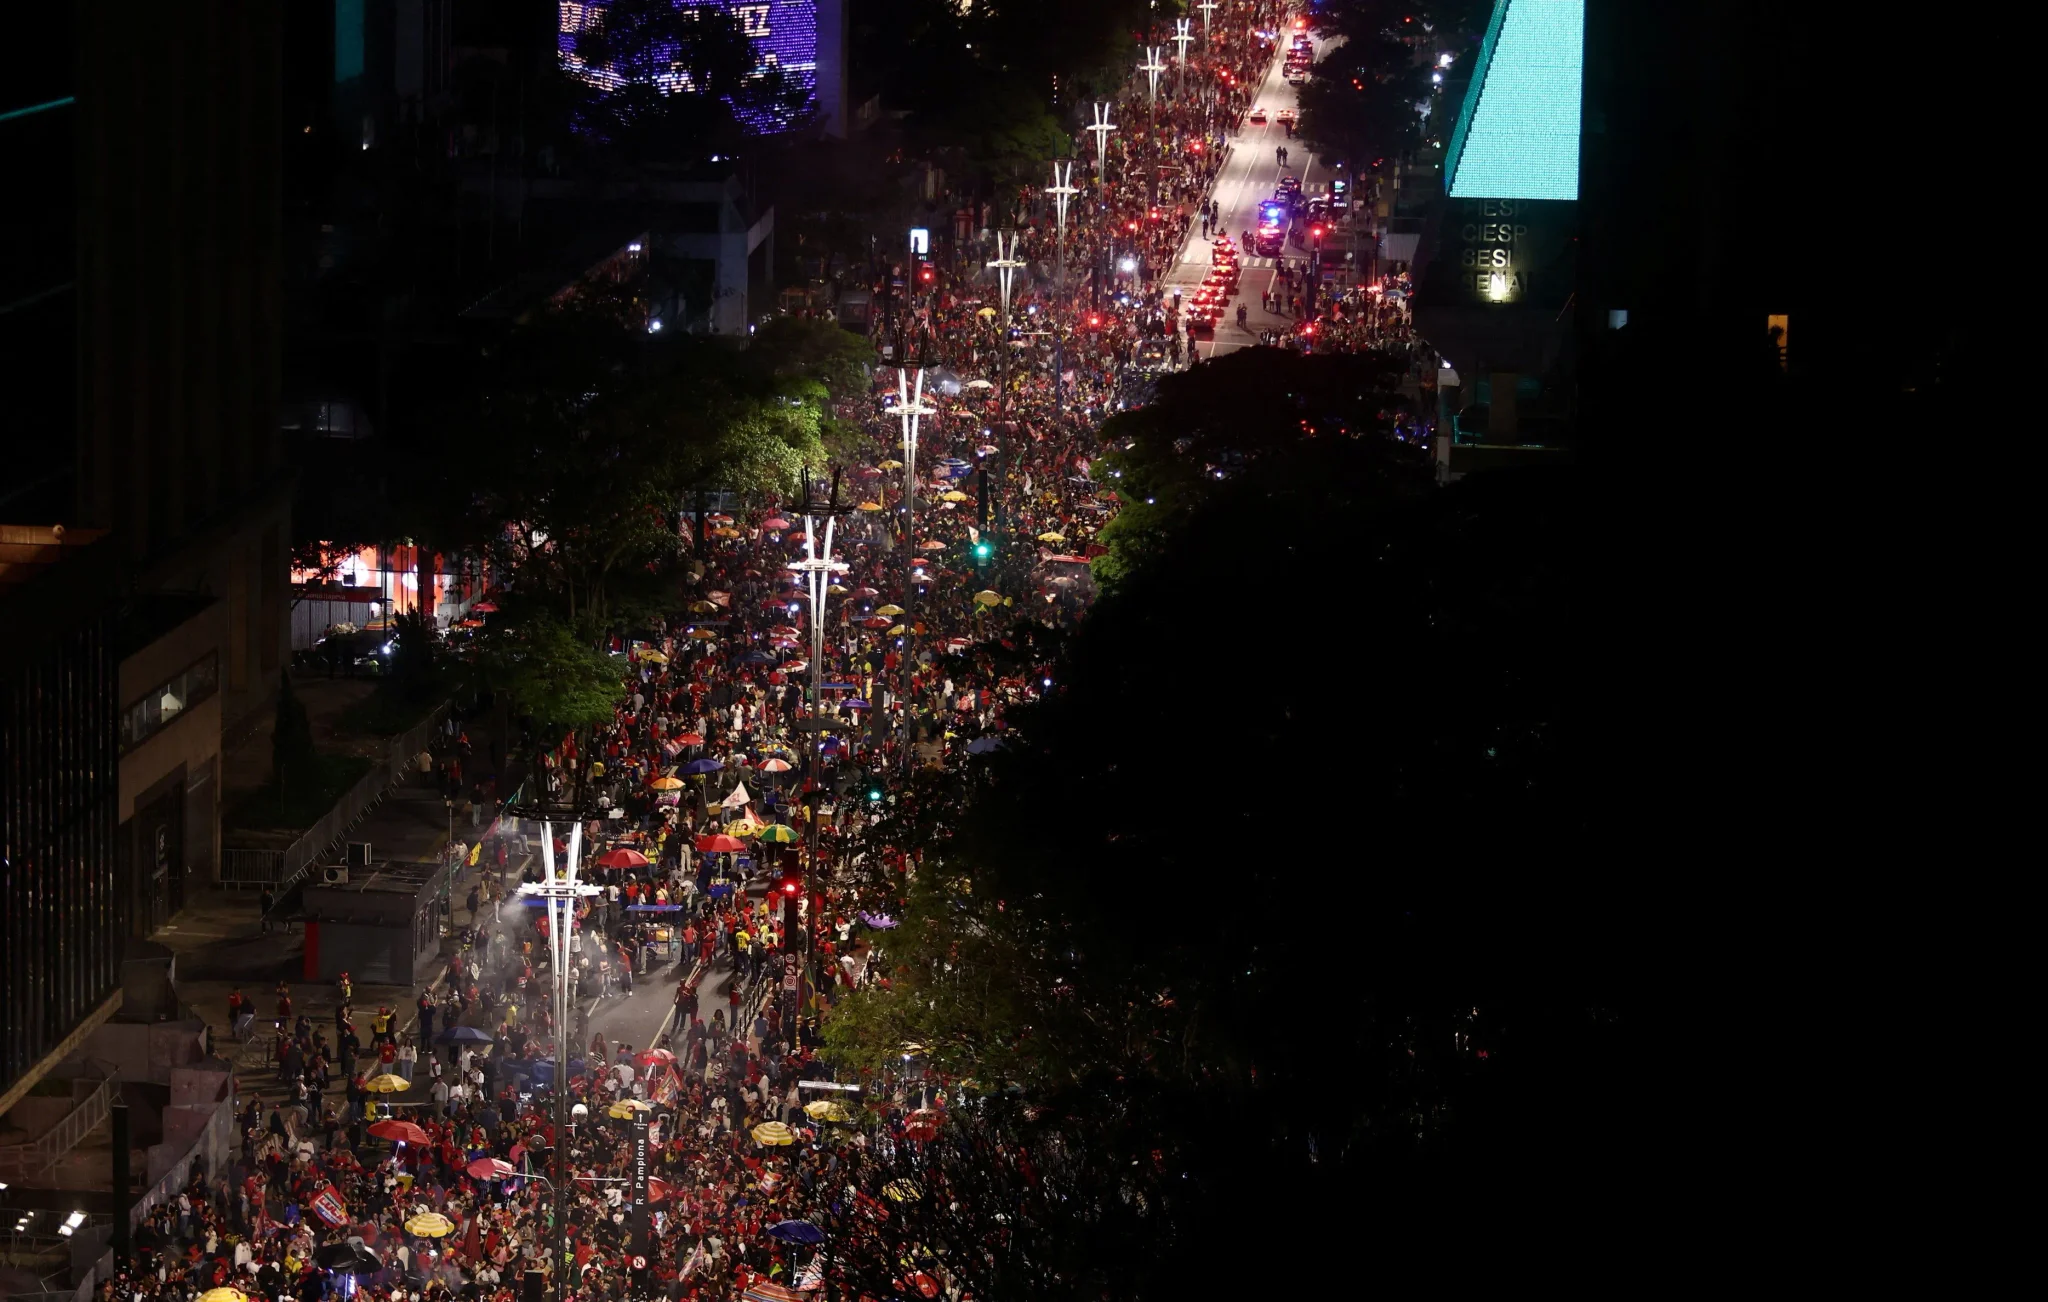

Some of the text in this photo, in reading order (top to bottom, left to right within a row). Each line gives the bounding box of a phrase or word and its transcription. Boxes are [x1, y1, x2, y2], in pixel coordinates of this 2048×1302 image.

[1463, 199, 1528, 217] FIESP
[1462, 223, 1528, 243] CIESP
[1462, 248, 1511, 268] SESI
[1462, 273, 1529, 293] SENAI
[635, 1138, 648, 1205] R. Pamplona
